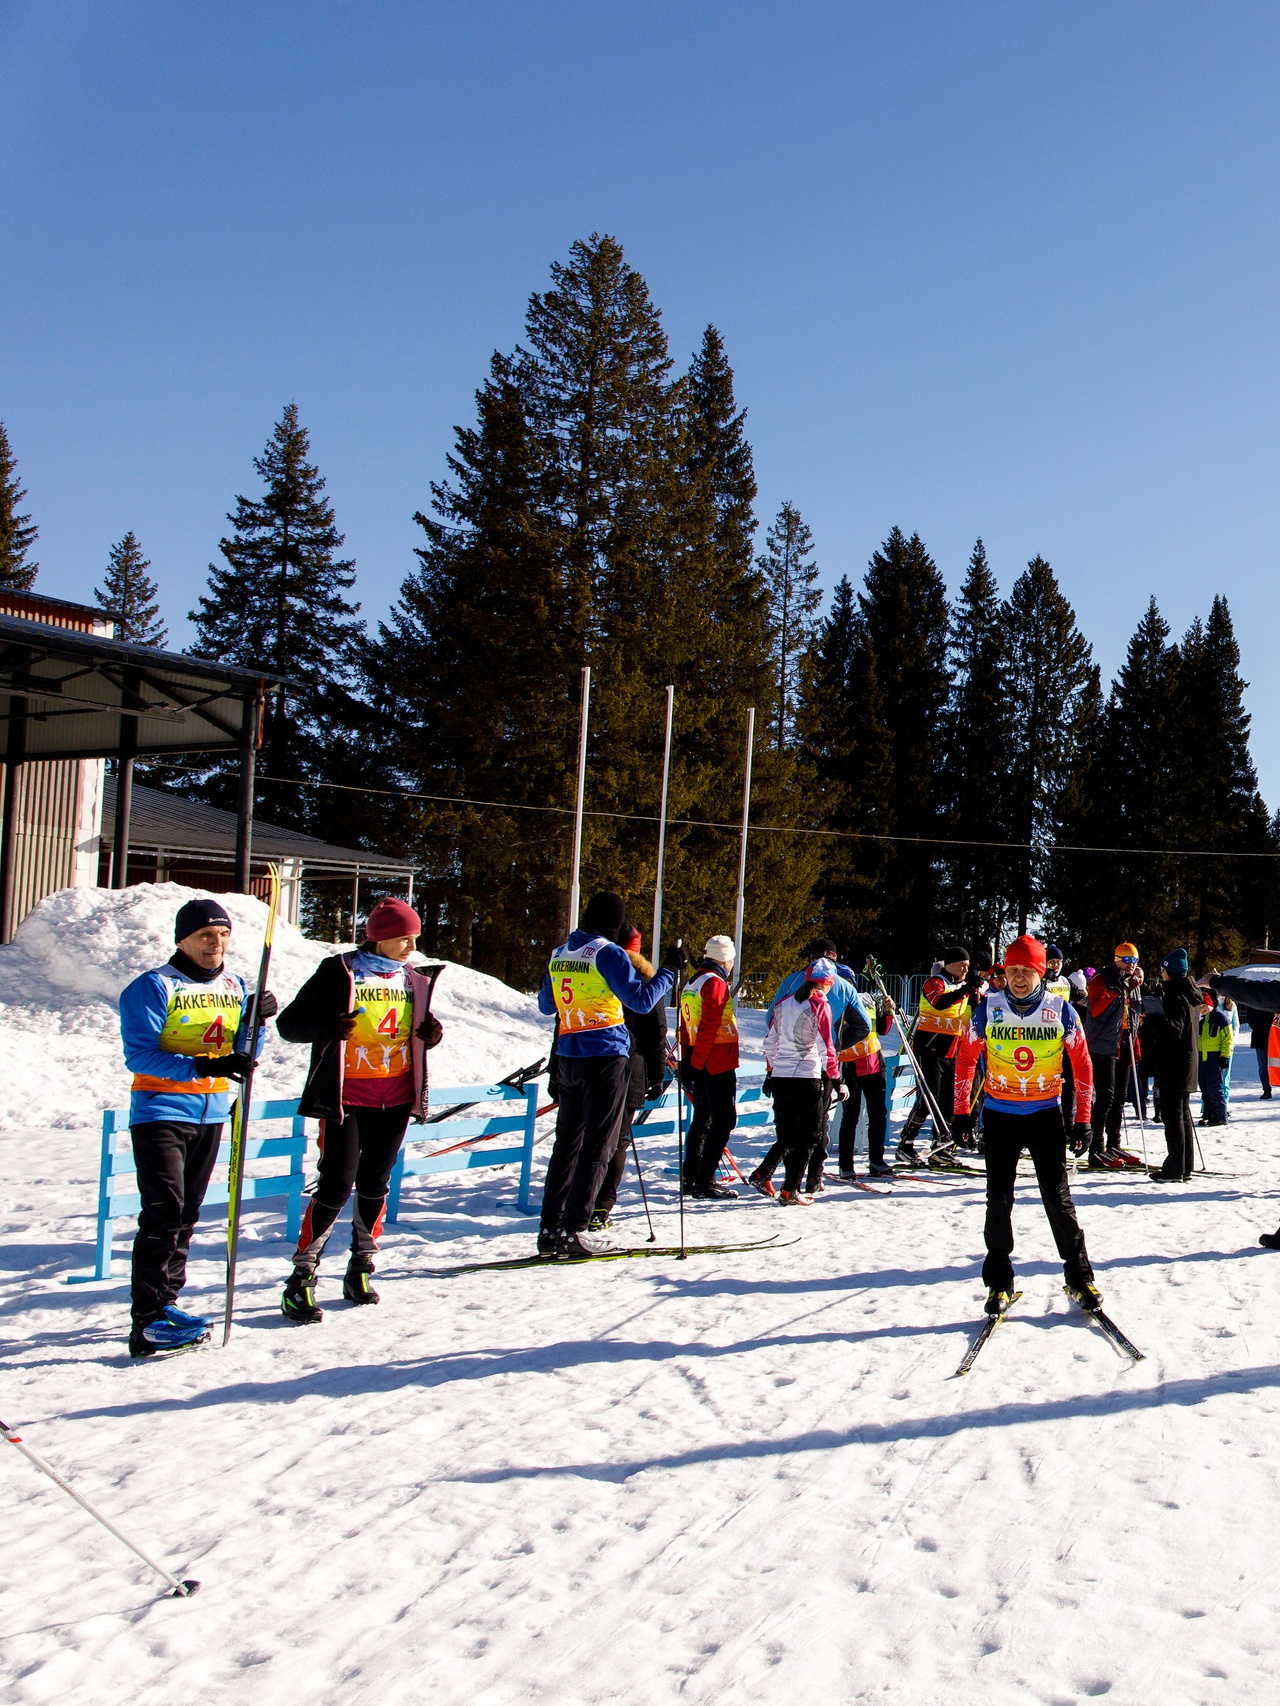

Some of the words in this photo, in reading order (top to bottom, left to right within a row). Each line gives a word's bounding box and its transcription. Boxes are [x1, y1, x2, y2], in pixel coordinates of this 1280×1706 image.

[550, 960, 590, 974] AKKERMANN
[560, 976, 574, 1005] 5
[377, 1007, 400, 1040] 4
[684, 1002, 691, 1023] 9
[202, 1014, 226, 1051] 4
[991, 1026, 1058, 1041] AKKERMANN
[1013, 1045, 1036, 1073] 9
